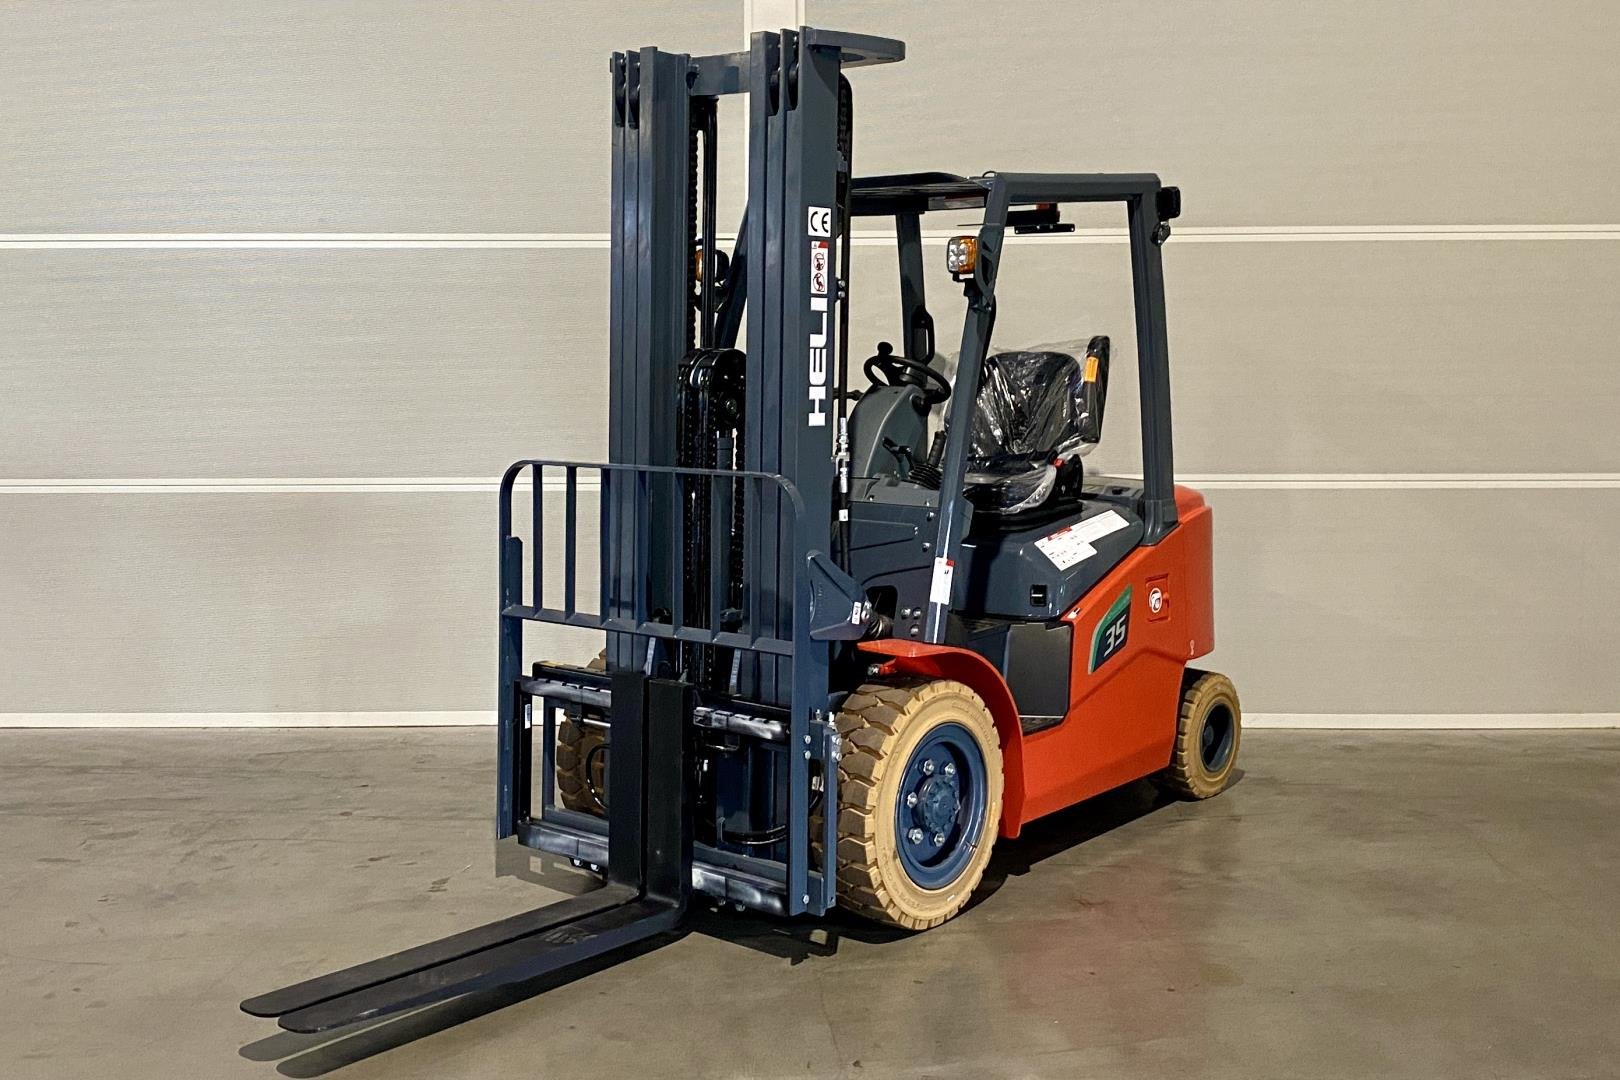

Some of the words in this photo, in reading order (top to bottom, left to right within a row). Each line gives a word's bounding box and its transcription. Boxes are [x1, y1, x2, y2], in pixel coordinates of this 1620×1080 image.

[810, 210, 829, 233] CE
[808, 297, 828, 427] HELI
[1103, 614, 1127, 657] 35
